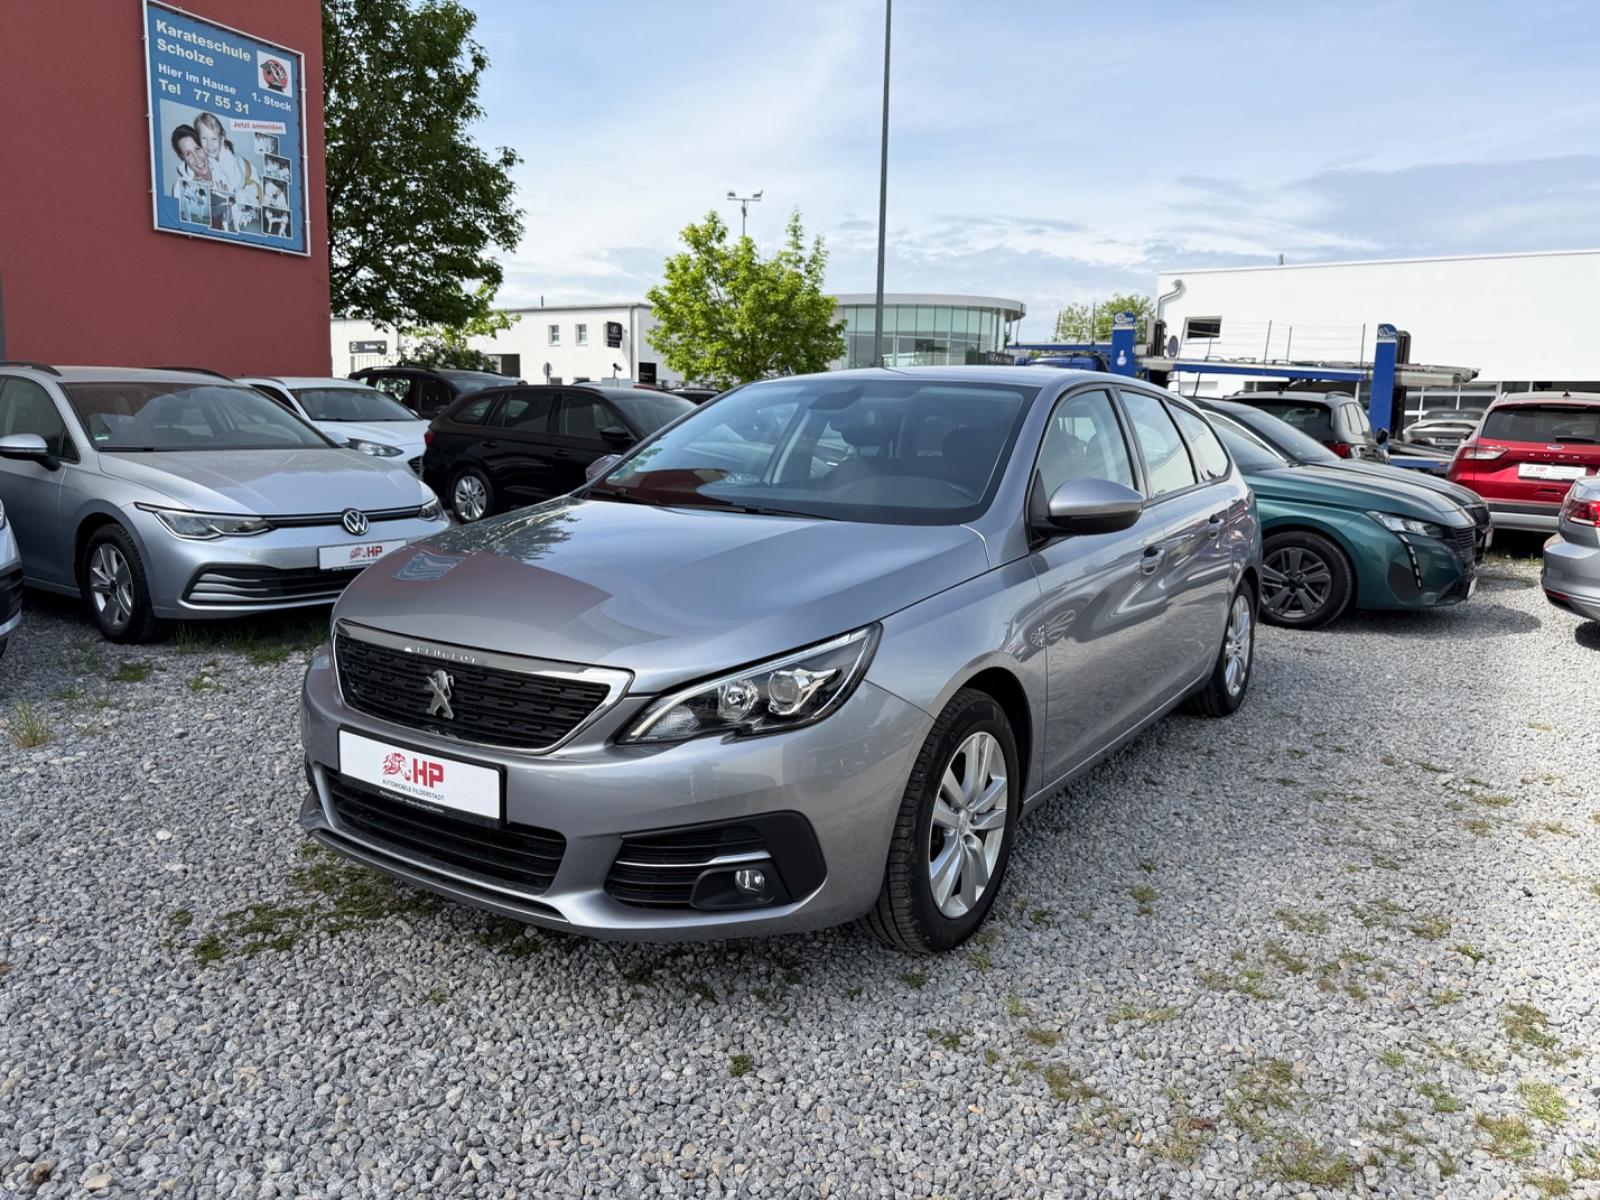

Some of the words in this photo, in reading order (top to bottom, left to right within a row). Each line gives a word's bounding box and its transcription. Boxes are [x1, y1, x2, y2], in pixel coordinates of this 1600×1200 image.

[156, 19, 251, 62] Karateschule
[157, 38, 214, 66] Scholze
[158, 63, 183, 78] Hier
[185, 71, 199, 84] im
[202, 76, 236, 94] Hause
[158, 78, 181, 95] Tel
[193, 89, 210, 103] 77
[215, 95, 231, 109] 55
[234, 101, 249, 115] 31
[251, 92, 261, 103] 1.
[263, 95, 292, 112] Stock
[366, 545, 383, 558] HP
[412, 757, 444, 789] HP
